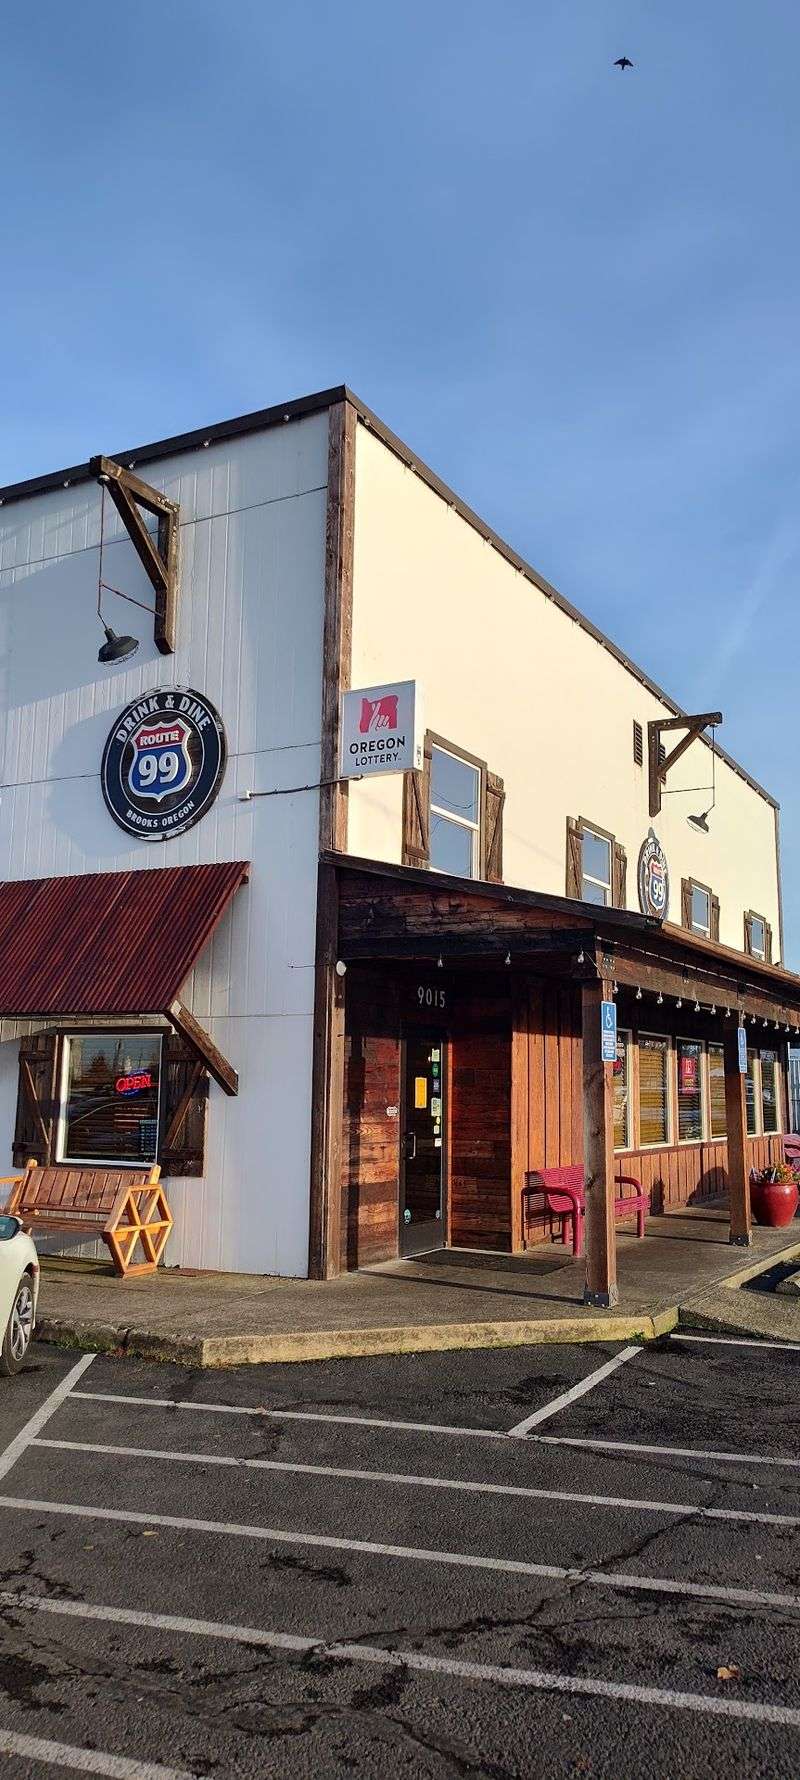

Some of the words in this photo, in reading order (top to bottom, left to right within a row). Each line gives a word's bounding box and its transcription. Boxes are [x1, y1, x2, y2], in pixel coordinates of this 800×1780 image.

[116, 696, 159, 743] DRINK
[165, 694, 175, 708] &
[179, 696, 211, 731] DINE
[139, 730, 180, 747] ROUTE
[349, 736, 406, 754] OREGON
[138, 752, 179, 787] 99
[355, 752, 400, 767] LOTTERY
[126, 809, 159, 828] BROOKS
[161, 800, 195, 827] OREGON
[653, 879, 663, 902] 99
[417, 985, 446, 1009] 9015
[115, 1074, 152, 1092] OPEN
